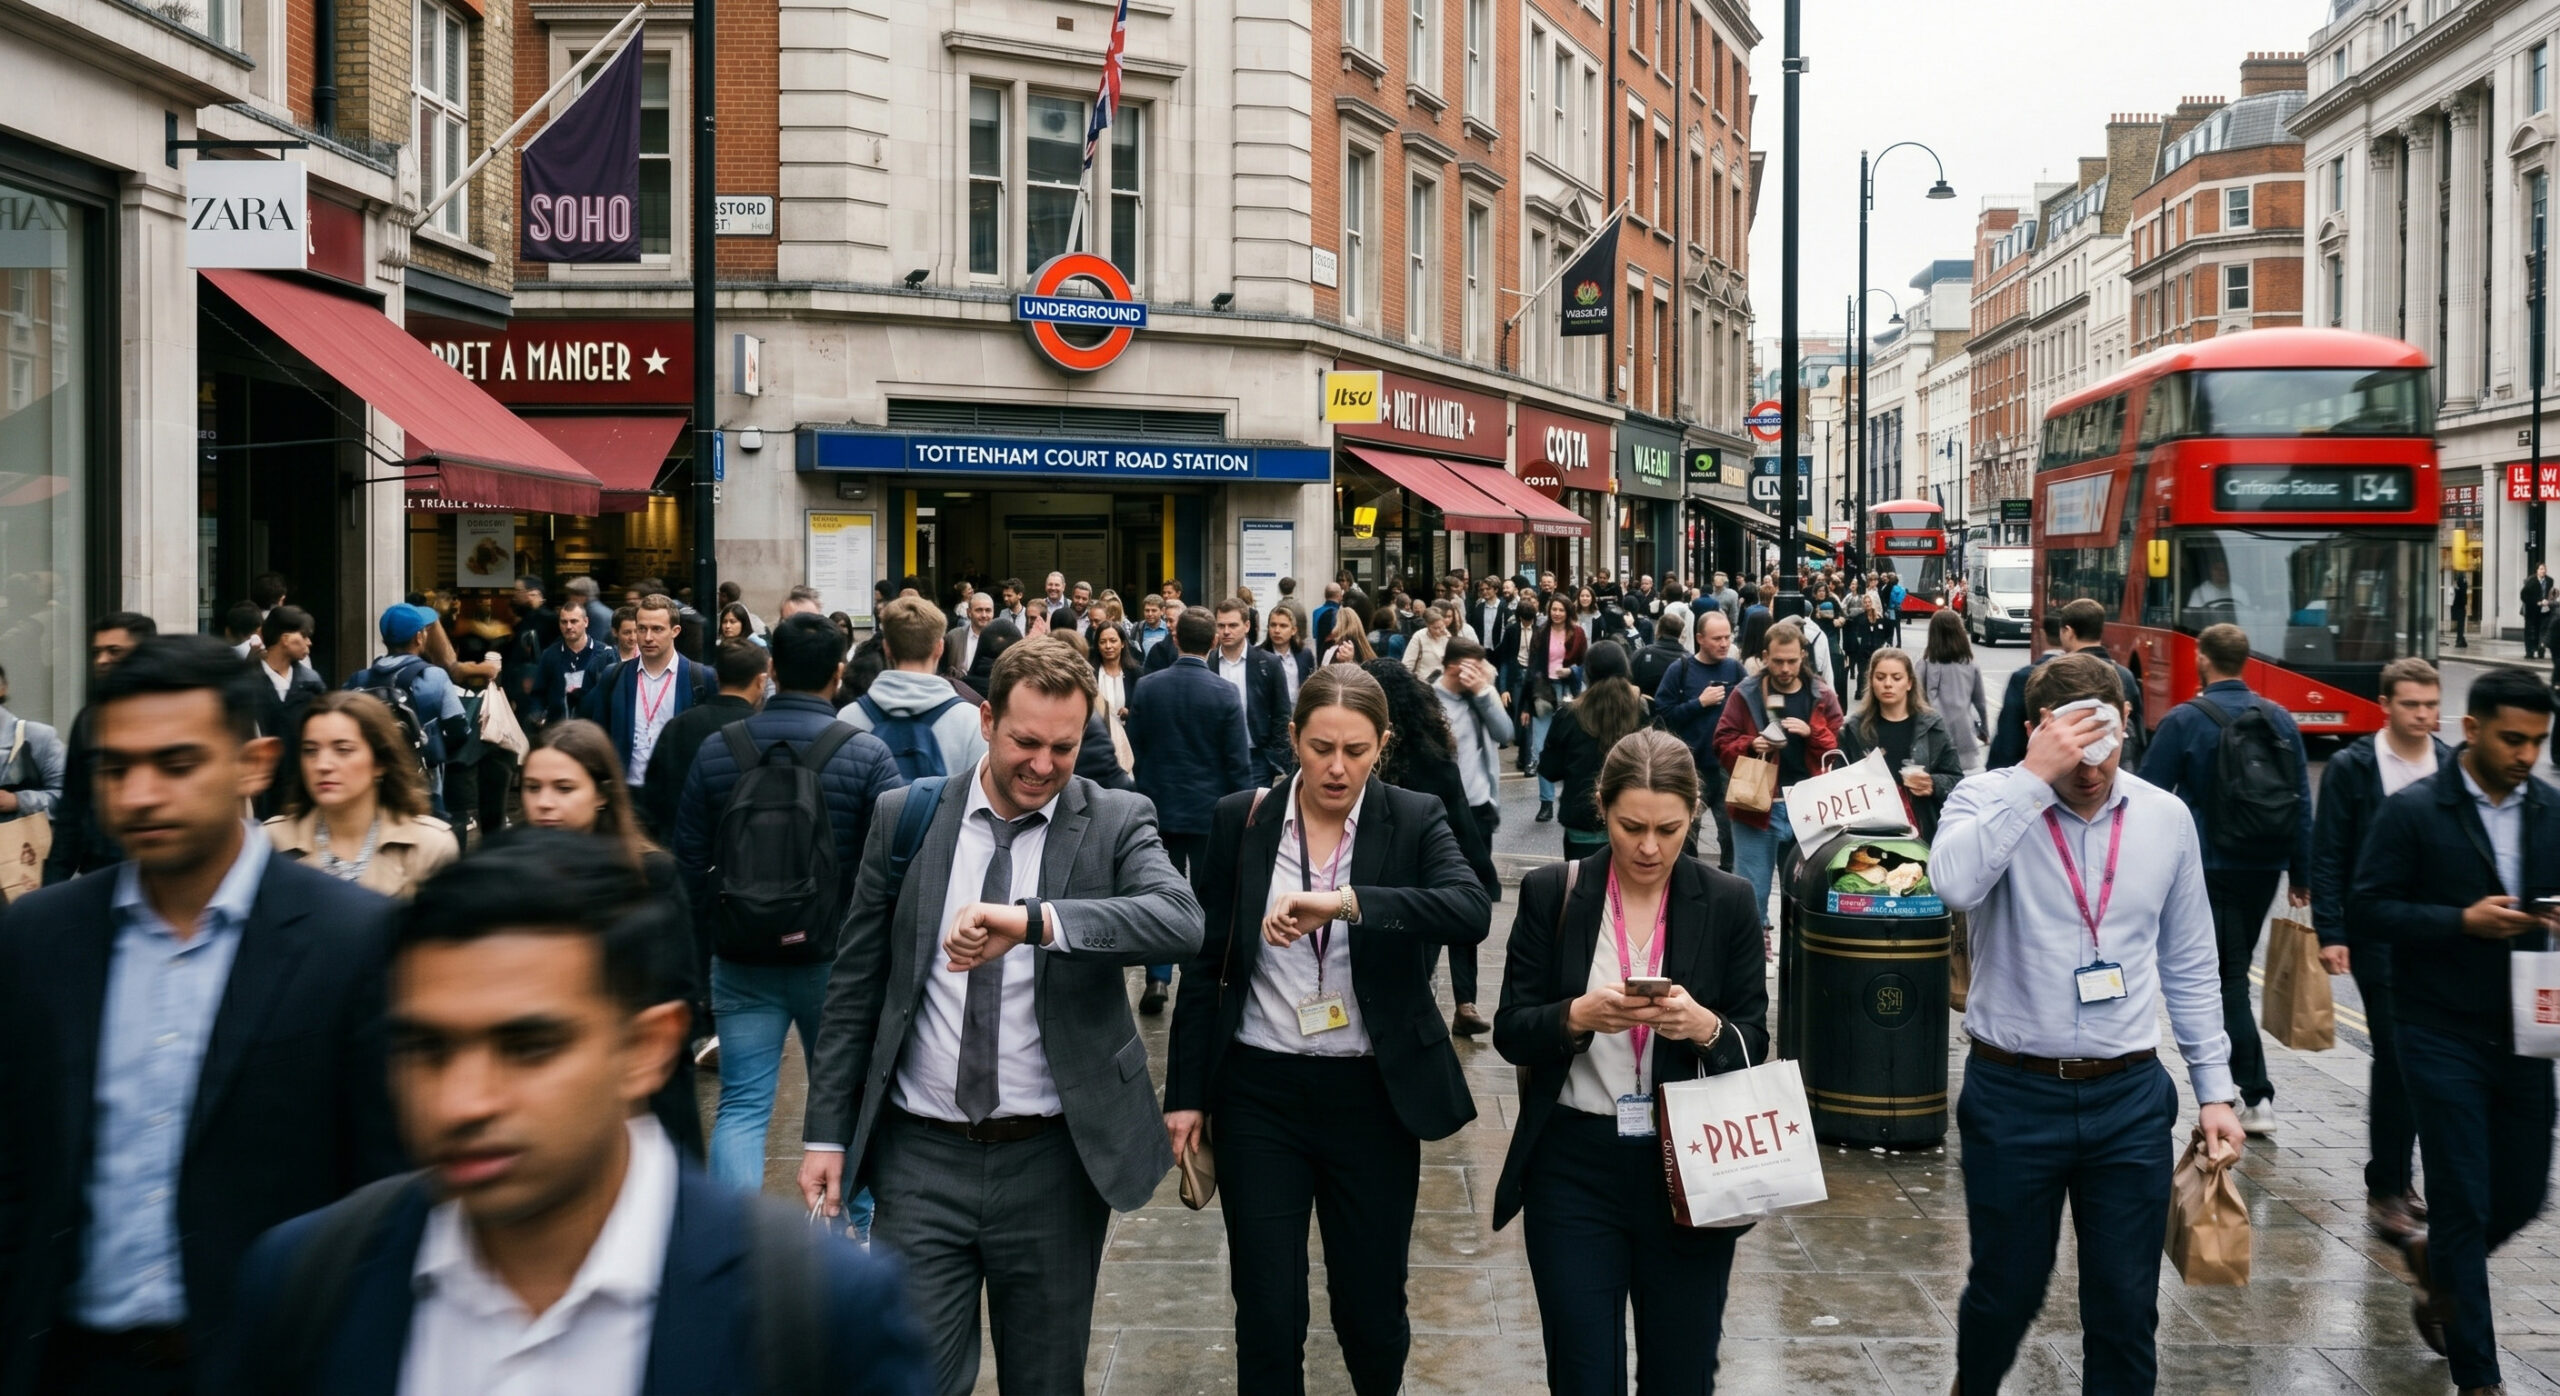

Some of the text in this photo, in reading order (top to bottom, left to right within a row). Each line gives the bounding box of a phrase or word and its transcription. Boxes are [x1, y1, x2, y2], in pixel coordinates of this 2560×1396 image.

[191, 197, 298, 231] ZARA
[529, 193, 631, 242] SOHO
[1024, 301, 1141, 322] UNDERGROUND
[500, 340, 517, 381] A
[528, 340, 631, 381] MANGER
[1394, 389, 1465, 440] PRET A MANGER
[916, 445, 1248, 471] TOTTENHAM COURT ROAD STATION
[1546, 425, 1589, 472] COSTA
[1524, 476, 1558, 487] COSTA
[2353, 474, 2398, 501] 134
[1817, 784, 1871, 825] PRET
[1702, 1110, 1783, 1164] PRET
